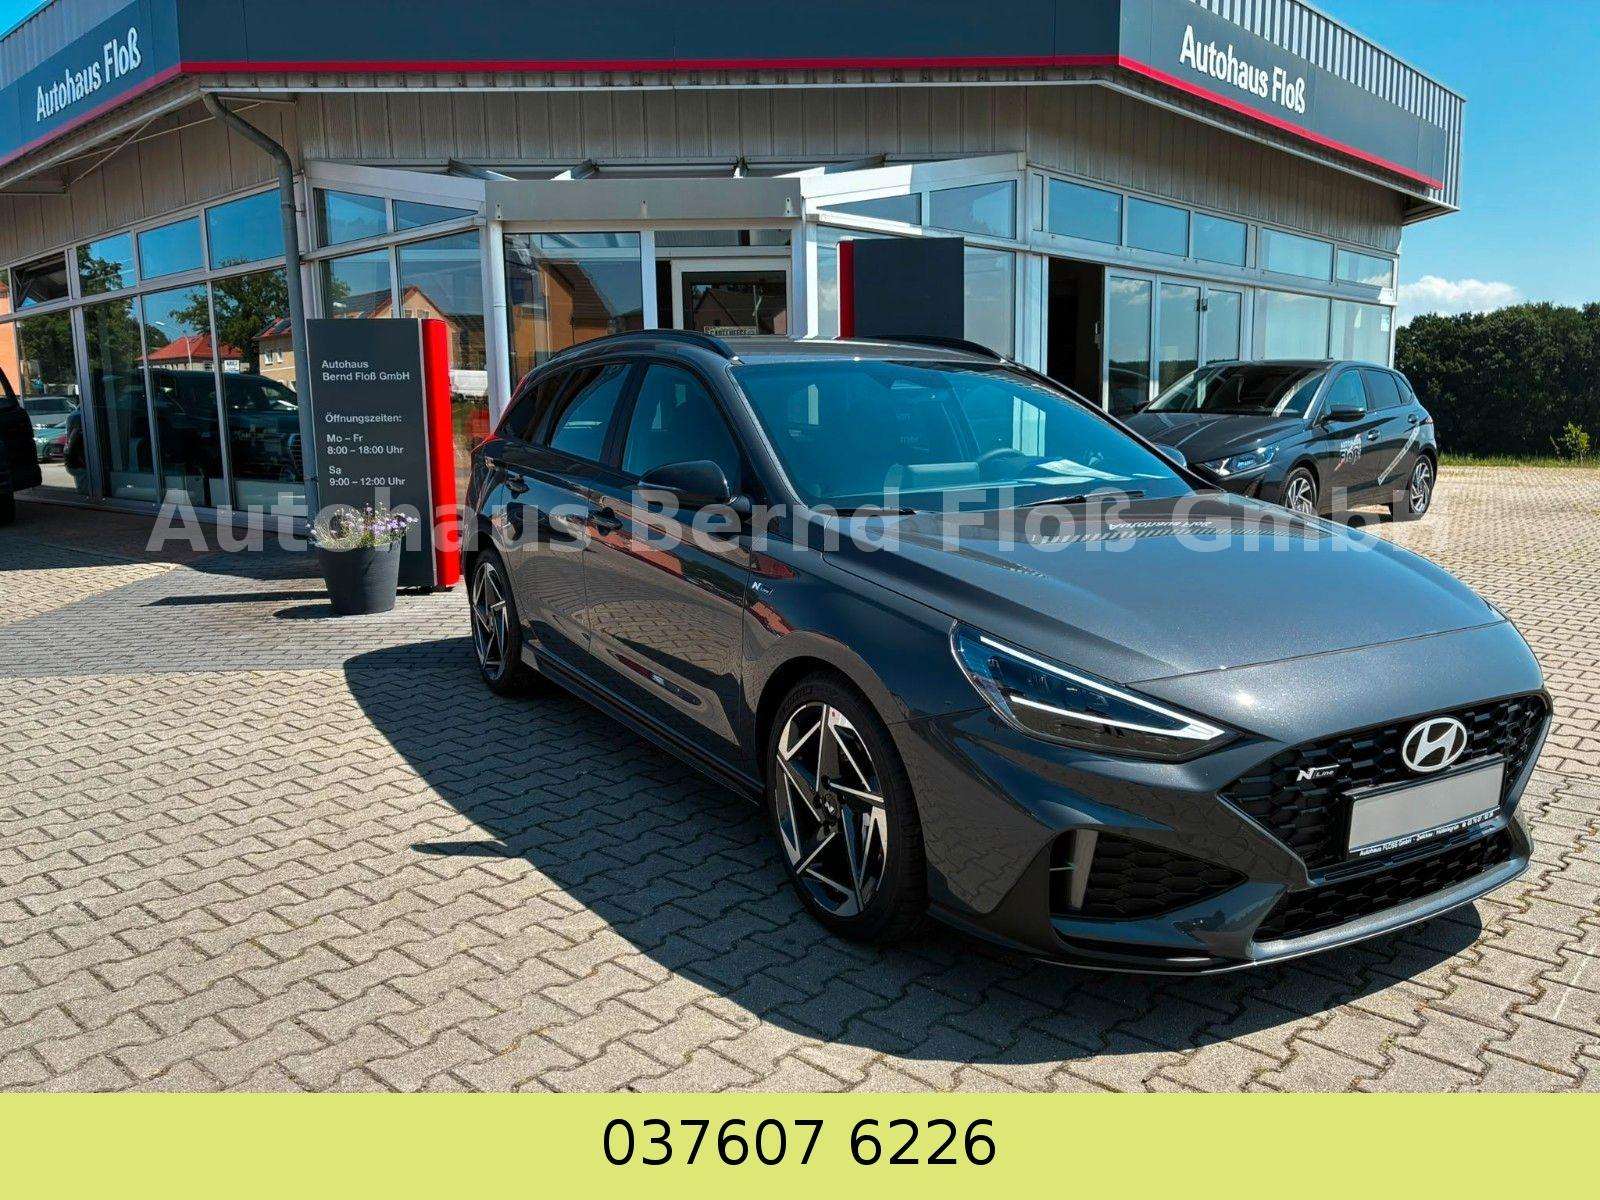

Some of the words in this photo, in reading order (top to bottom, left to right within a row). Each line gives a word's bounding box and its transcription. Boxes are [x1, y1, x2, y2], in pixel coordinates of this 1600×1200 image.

[1179, 24, 1269, 98] Autohaus
[1271, 65, 1306, 114] Floß
[37, 61, 102, 122] Autohaus
[103, 27, 142, 83] Floß
[322, 360, 369, 369] Autohaus
[323, 372, 353, 381] Bernd
[355, 371, 377, 381] Floß
[379, 371, 410, 380] GmbH
[325, 411, 402, 424] Öffnungszeiten:
[327, 434, 342, 443] Mo
[353, 434, 363, 442] Fr
[327, 446, 348, 455] 8:00
[359, 445, 384, 454] 18:00
[386, 445, 404, 454] Uhr
[329, 466, 342, 475] Sa
[329, 477, 350, 486] 9:00
[360, 477, 386, 486] 12:00
[388, 477, 406, 486] Uhr
